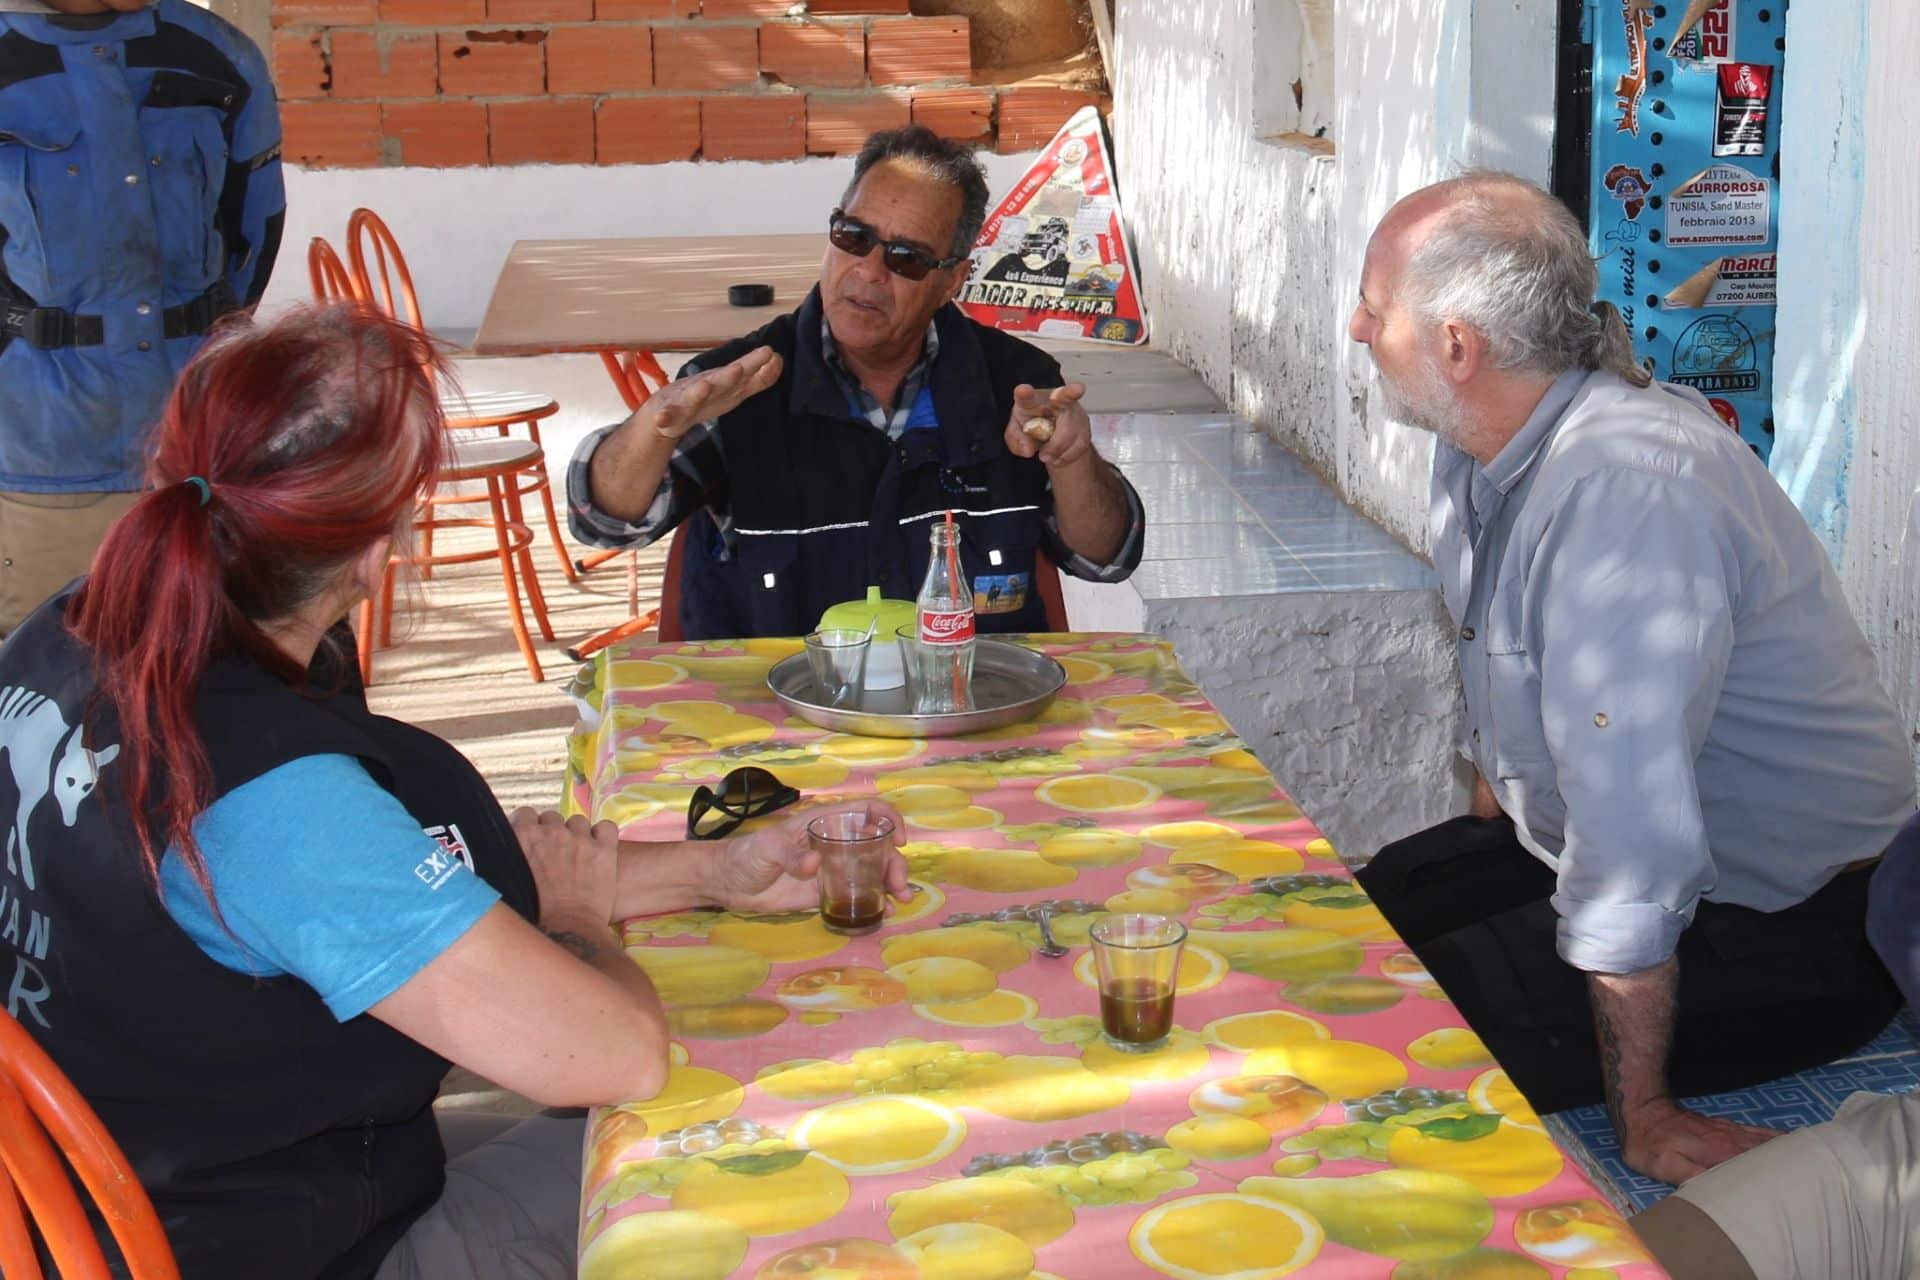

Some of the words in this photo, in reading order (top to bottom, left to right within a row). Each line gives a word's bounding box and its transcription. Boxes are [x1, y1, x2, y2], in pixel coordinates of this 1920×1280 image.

[1669, 201, 1708, 212] TUNISIA,
[1710, 201, 1733, 211] Sand
[1735, 200, 1763, 211] Master
[1680, 216, 1726, 227] febbraio
[1729, 215, 1756, 226] 2013
[1020, 272, 1065, 286] Experience
[1716, 292, 1744, 300] 07200
